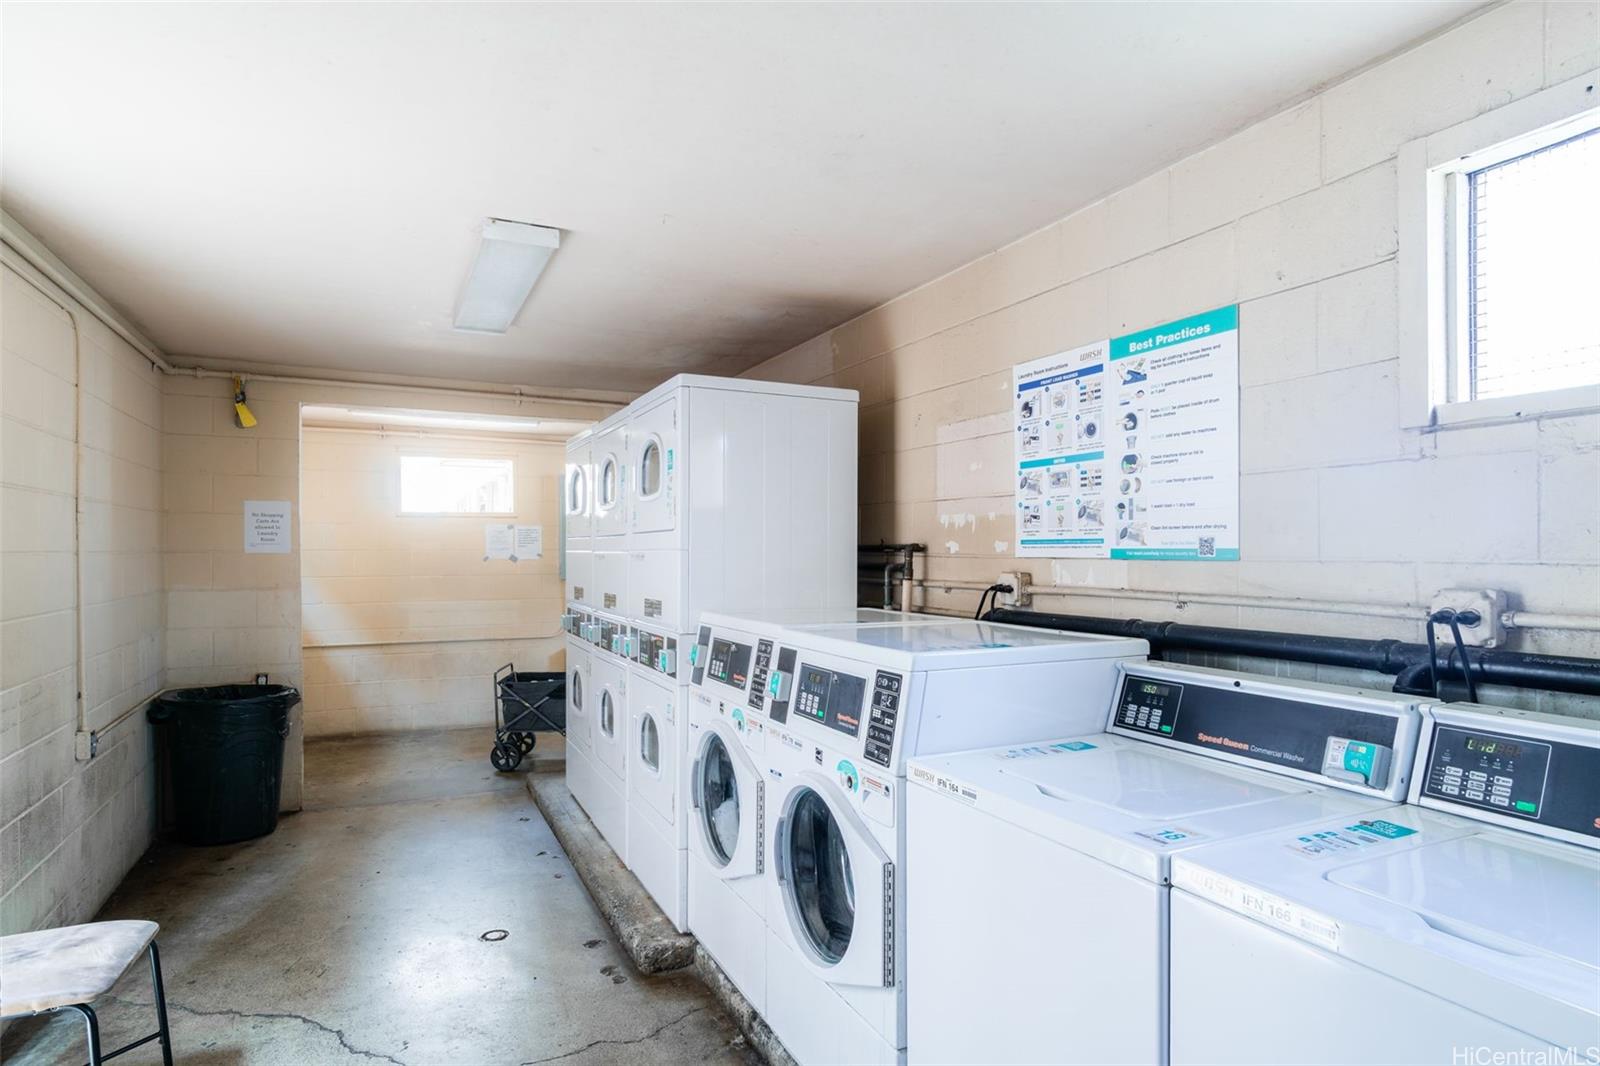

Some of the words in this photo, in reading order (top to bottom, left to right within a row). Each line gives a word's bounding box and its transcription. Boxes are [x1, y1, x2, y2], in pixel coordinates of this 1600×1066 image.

[1128, 338, 1152, 352] Best
[1156, 324, 1211, 345] Practices
[1186, 353, 1210, 362] instructions
[1045, 363, 1068, 372] Instructions
[1198, 732, 1223, 745] Speed
[1223, 738, 1249, 750] Queen
[1250, 745, 1282, 758] Commercial
[1283, 752, 1304, 762] Washer
[949, 783, 959, 792] 164
[1242, 893, 1264, 912] IFN
[1268, 904, 1291, 922] 166
